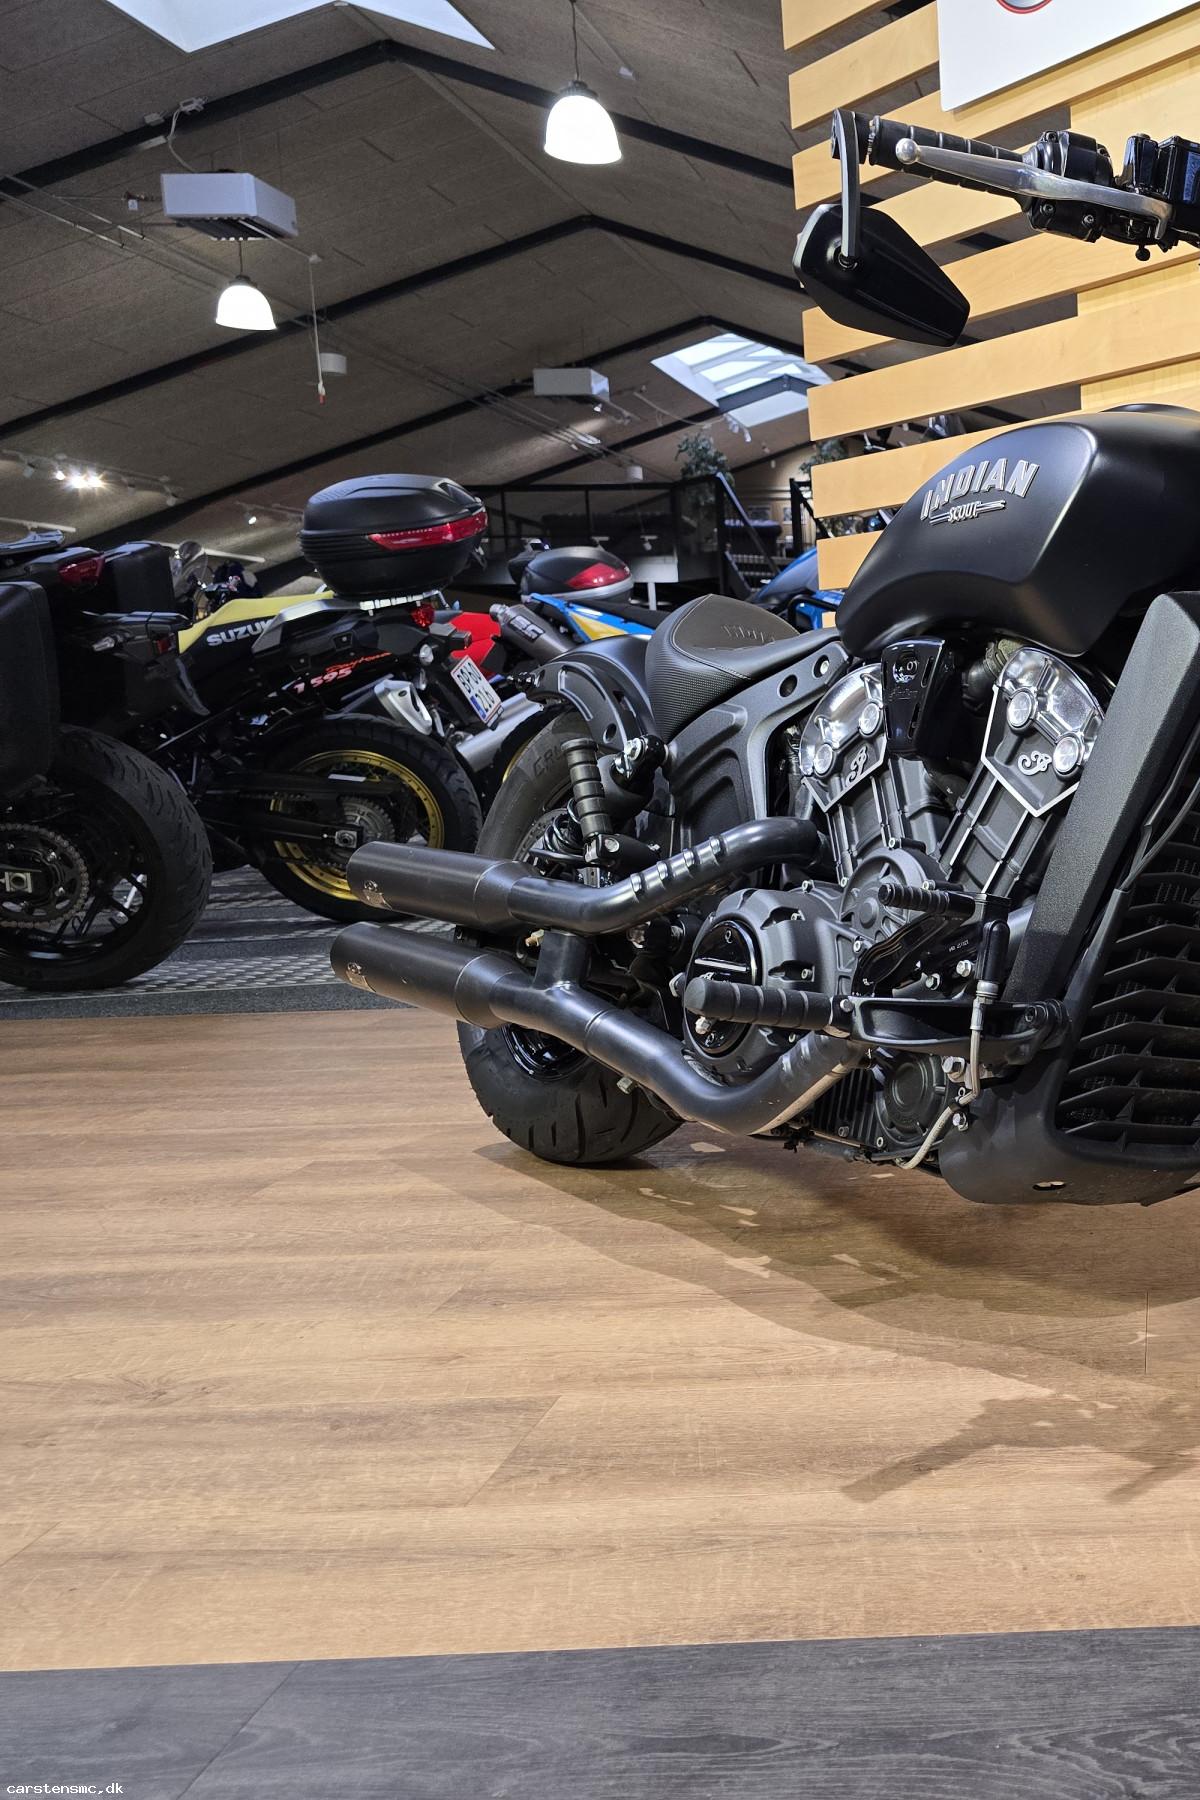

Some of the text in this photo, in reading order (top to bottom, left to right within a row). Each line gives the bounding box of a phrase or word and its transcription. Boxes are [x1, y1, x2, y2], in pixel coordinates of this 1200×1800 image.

[920, 458, 1040, 521] INDIAN
[948, 501, 981, 523] SCOUT
[206, 619, 273, 646] SUZUK
